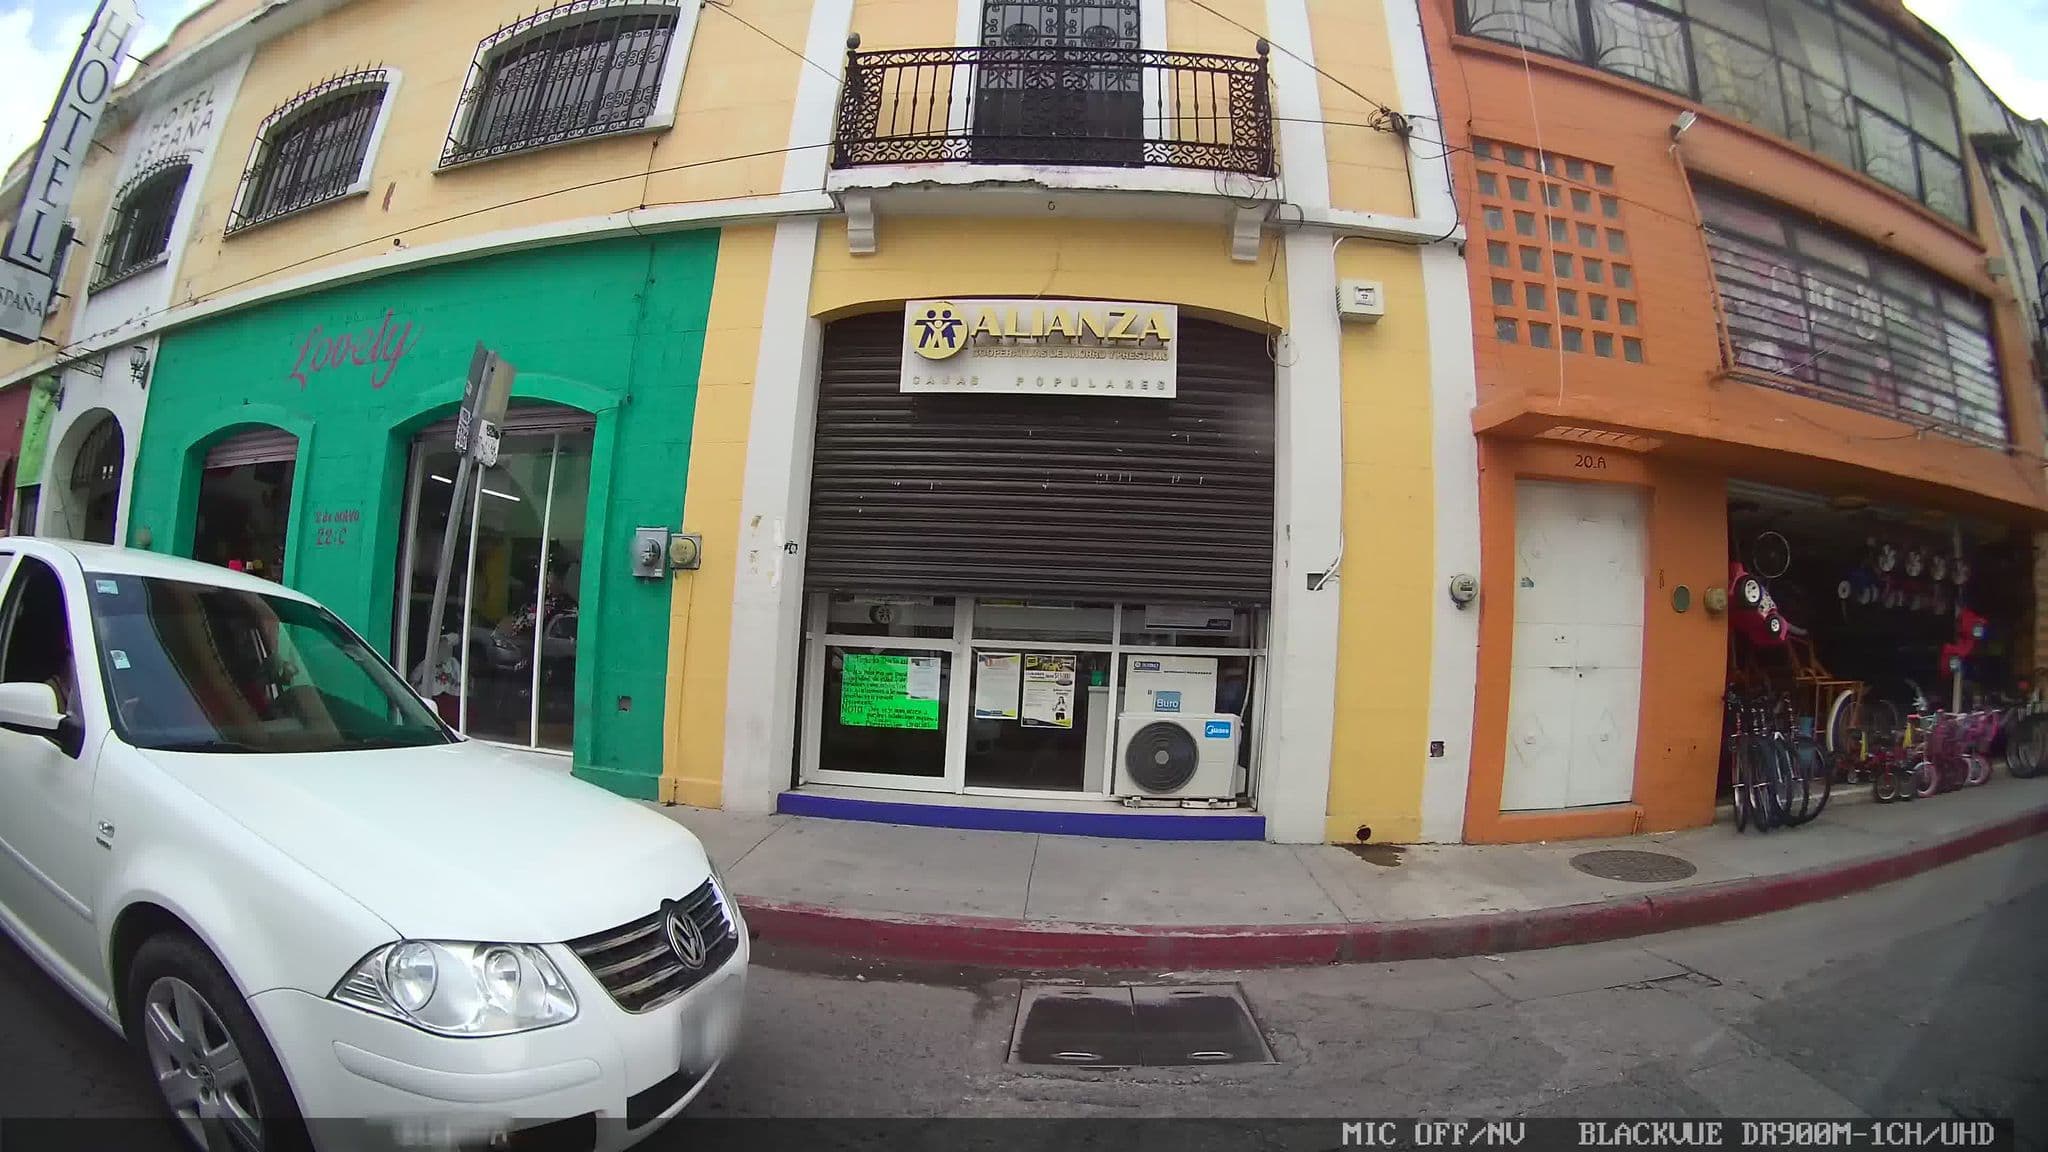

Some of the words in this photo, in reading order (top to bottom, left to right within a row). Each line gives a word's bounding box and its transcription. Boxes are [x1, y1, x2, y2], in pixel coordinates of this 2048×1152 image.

[21, 10, 133, 263] HOTEL
[151, 85, 214, 138] HOTEL
[289, 308, 425, 390] Lovely
[970, 307, 1171, 342] ALIANZA
[1015, 377, 1166, 391] POPULARES
